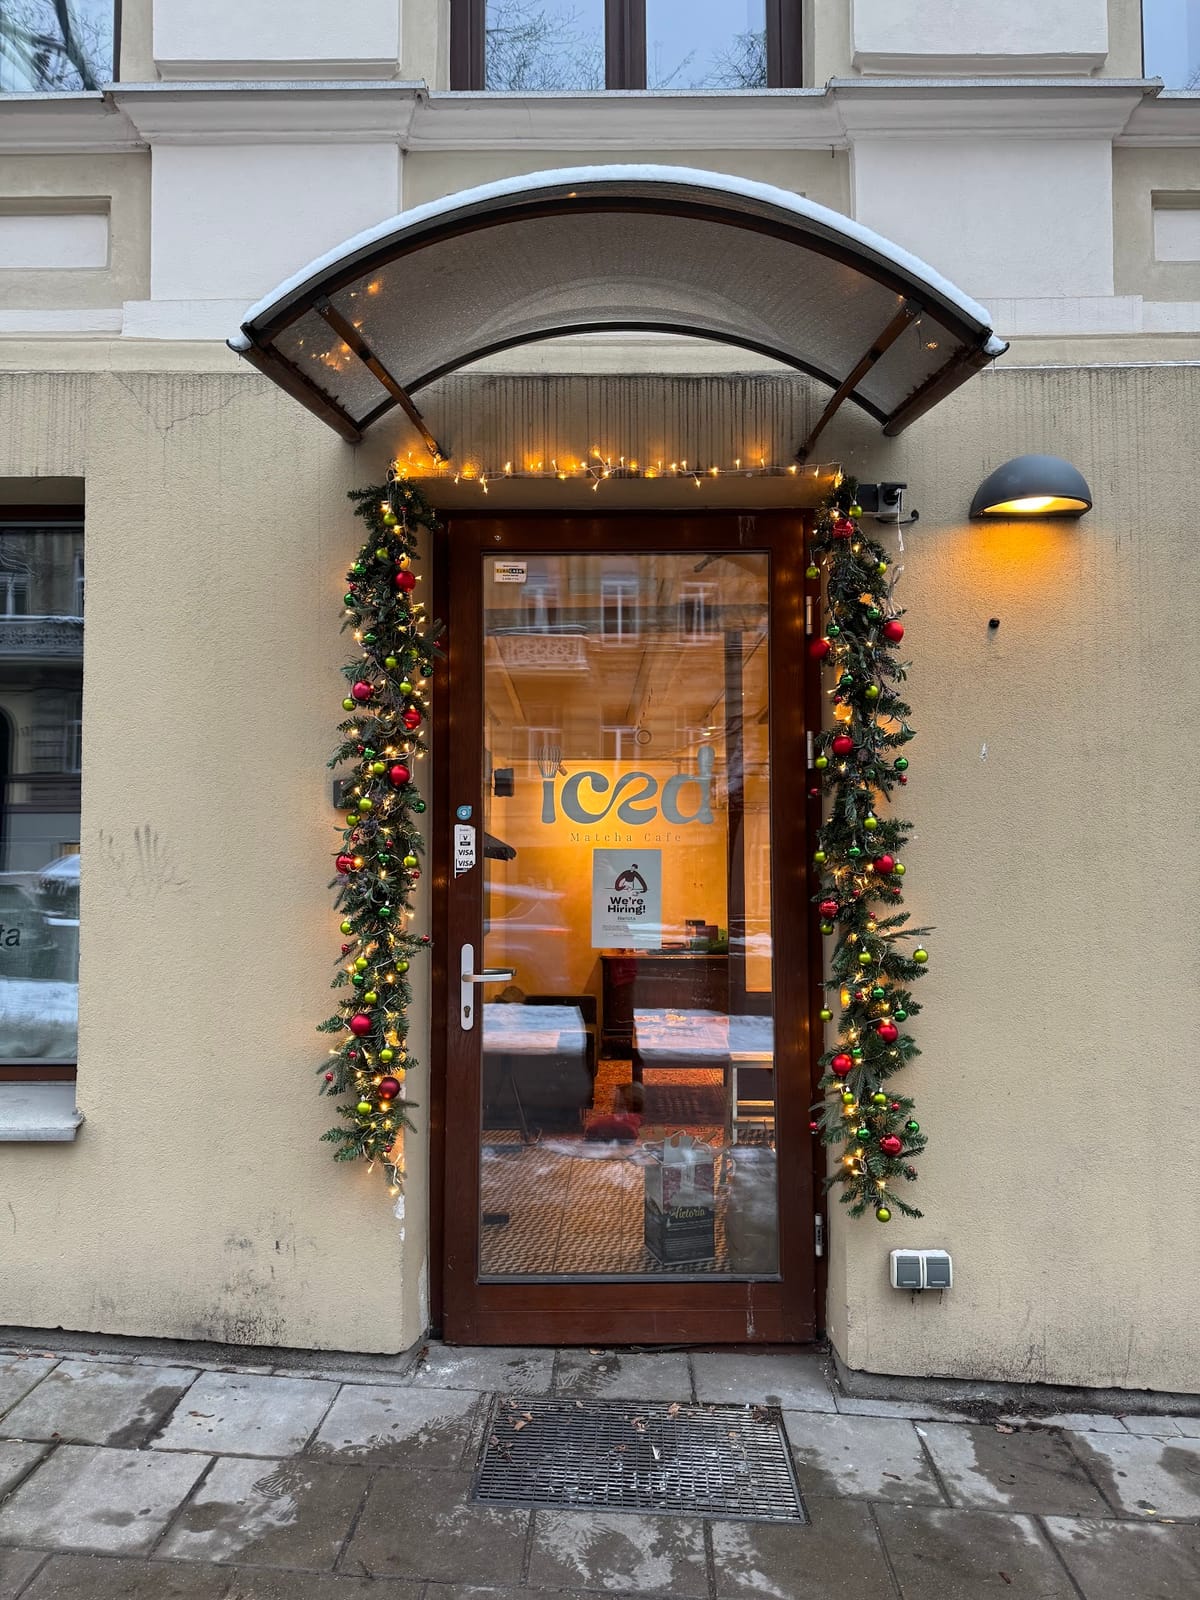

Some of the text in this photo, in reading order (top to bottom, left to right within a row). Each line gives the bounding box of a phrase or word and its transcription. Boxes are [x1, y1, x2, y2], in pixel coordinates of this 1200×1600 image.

[570, 832, 682, 843] Matcha Cafe
[610, 897, 644, 905] We're
[608, 905, 646, 915] Hiring!
